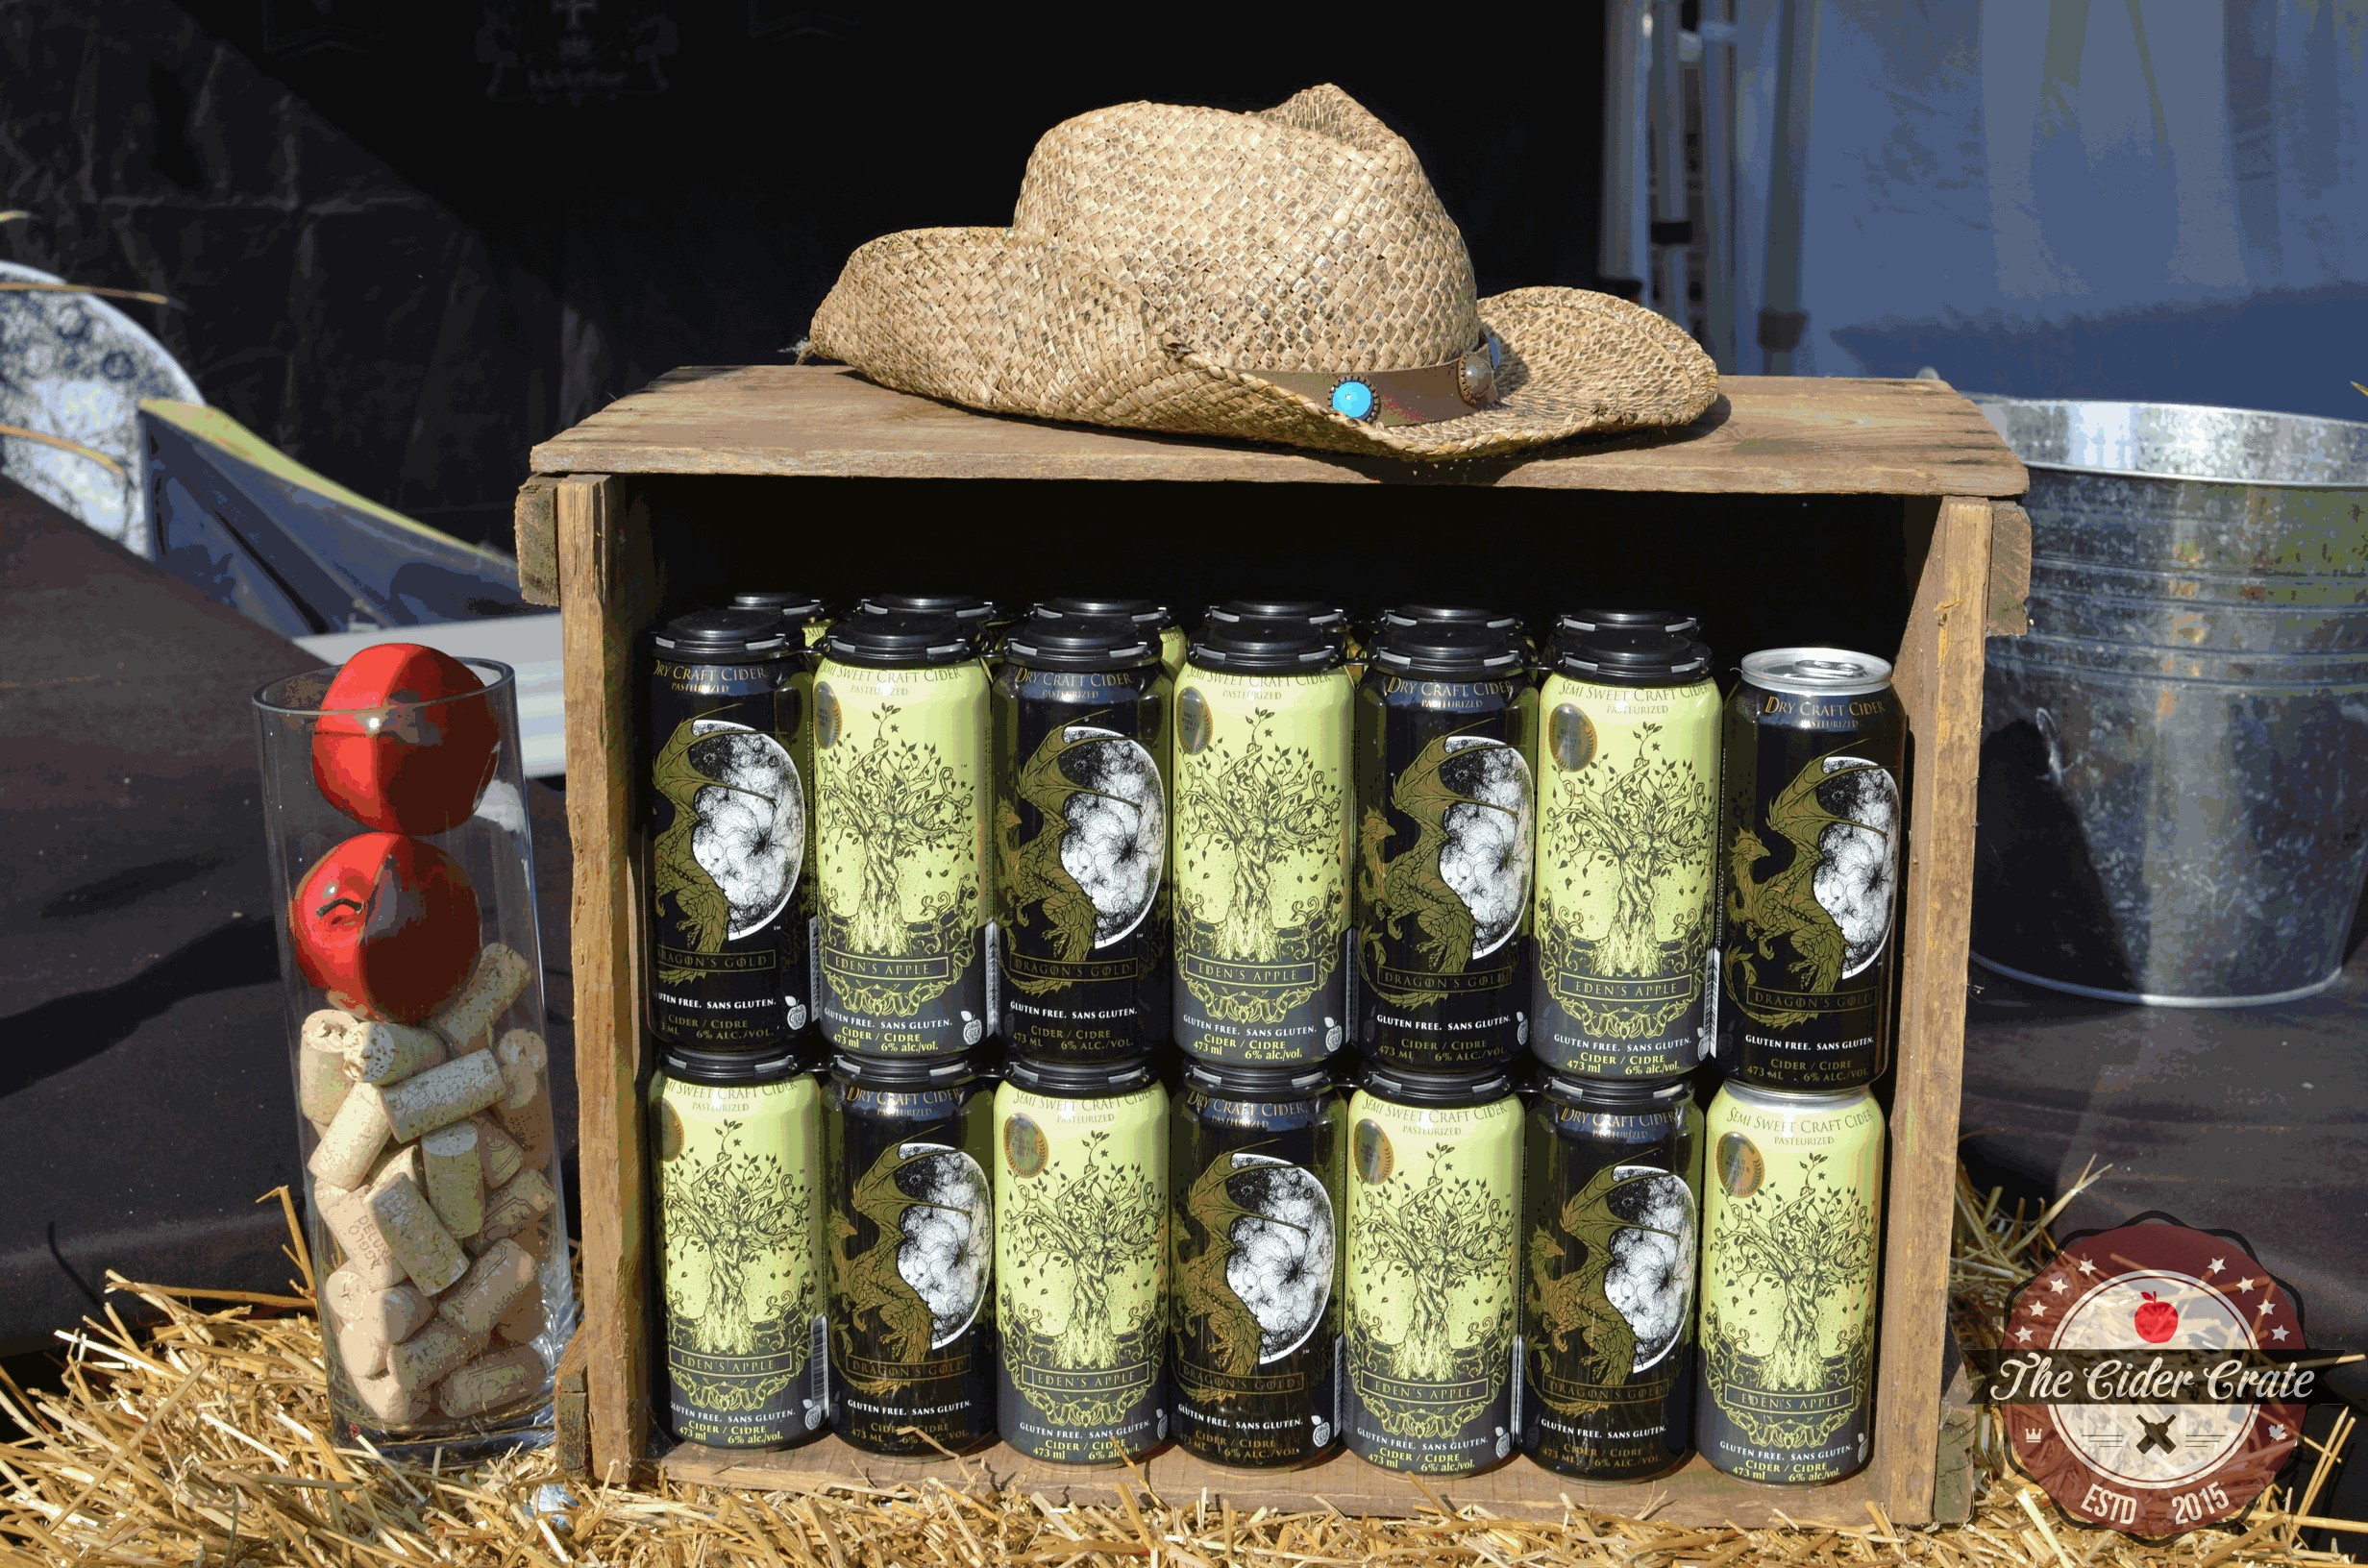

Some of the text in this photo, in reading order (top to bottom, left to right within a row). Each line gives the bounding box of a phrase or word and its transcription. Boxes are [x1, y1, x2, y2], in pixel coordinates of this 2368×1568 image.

[822, 661, 963, 683] SEMI SWEET CRAFT CIDER
[1015, 667, 1134, 687] DRY CRAFT CIDER
[1207, 672, 1243, 686] SWEET
[1250, 675, 1290, 687] CRAFT
[1295, 672, 1332, 685] CIDER
[1387, 677, 1512, 697] DRY CRAFT CIDER
[1559, 680, 1710, 701] SEMI SWEET CRAFT CIDER
[1765, 696, 1886, 717] DRY CRAFT CIDER
[725, 956, 766, 968] GOLD
[836, 956, 929, 975] EDEN'S APPLE
[1091, 965, 1130, 976] GOLD
[1199, 964, 1297, 981] EDEN'S APPLE
[1385, 972, 1459, 988] DRAGON'S
[1576, 981, 1677, 996] EDEN'S APPLE
[825, 1007, 848, 1023] GLUTEN
[851, 1017, 875, 1028] FREE.
[910, 1018, 951, 1029] GLUTEN.
[1010, 1001, 1040, 1015] GLUTEN
[1043, 1009, 1067, 1018] FREE.
[1098, 1008, 1137, 1018] GLUTEN.
[1184, 1015, 1211, 1030] GLUTEN
[1215, 1024, 1240, 1035] FREE.
[1275, 1025, 1316, 1037] GLUTEN.
[1377, 1014, 1412, 1028] GLUTEN
[1416, 1021, 1442, 1030] FREE.
[1475, 1016, 1511, 1029] GLUTEN.
[833, 1033, 938, 1052] 473 ml 6% alc./vol.
[1194, 1041, 1302, 1060] 473 ml 6% alc./vol.
[1401, 1039, 1487, 1050] CIDER CIDRE
[1554, 1034, 1691, 1052] GLUTEN FREE. SANS GLUTEN.
[1745, 1035, 1781, 1048] GLUTEN
[1786, 1041, 1811, 1050] FREE.
[1842, 1037, 1873, 1049] GLUTEN.
[1580, 1052, 1665, 1065] CIDER CIDRE
[1771, 1059, 1852, 1070] CIDER CIDRE
[1567, 1060, 1680, 1075] 473 ml 6% alc./vol.
[677, 1084, 712, 1098] SWEET
[718, 1087, 757, 1099] CRAFT
[762, 1079, 798, 1095] CIDER
[1014, 1090, 1036, 1106] SEMI
[1082, 1098, 1121, 1111] CRAFT
[1124, 1088, 1154, 1105] CIDER
[1187, 1091, 1306, 1116] DRY CRAFT CIDER
[1362, 1096, 1507, 1123] SEMI SWEET CRAFT CIDER
[1727, 1107, 1874, 1133] SEMI SWEET CRAFT CIDER
[1403, 1126, 1461, 1136] PASTEURIZED
[1774, 1137, 1834, 1145] PASTEURIZED
[681, 1357, 774, 1372] EDEN'S APPLE
[1038, 1371, 1135, 1386] EDEN'S APPLE
[1255, 1378, 1295, 1390] GOLD
[1375, 1381, 1471, 1399] EDEN'S APPLE
[848, 1399, 878, 1413] GLUTEN
[882, 1407, 906, 1415] FREE.
[938, 1400, 971, 1414] GLUTEN.
[1741, 1393, 1839, 1409] EDEN'S APPLE
[1178, 1404, 1204, 1421] GLUTEN
[1207, 1416, 1230, 1427] FREE.
[1264, 1418, 1303, 1430] GLUTEN.
[689, 1421, 766, 1435] CIDER CIDRE
[1020, 1422, 1053, 1436] GLUTEN
[1117, 1420, 1150, 1435] GLUTEN.
[1542, 1419, 1574, 1434] GLUTEN
[1578, 1429, 1602, 1438] FREE.
[1634, 1425, 1666, 1438] GLUTEN.
[1196, 1430, 1276, 1447] CIDER CIDRE
[1357, 1427, 1387, 1444] GLUTEN
[1391, 1439, 1416, 1450] FREE.
[1450, 1437, 1488, 1449] GLUTEN.
[1380, 1447, 1460, 1463] CIDER CIDRE
[1745, 1459, 1827, 1473] CIDER CIDRE
